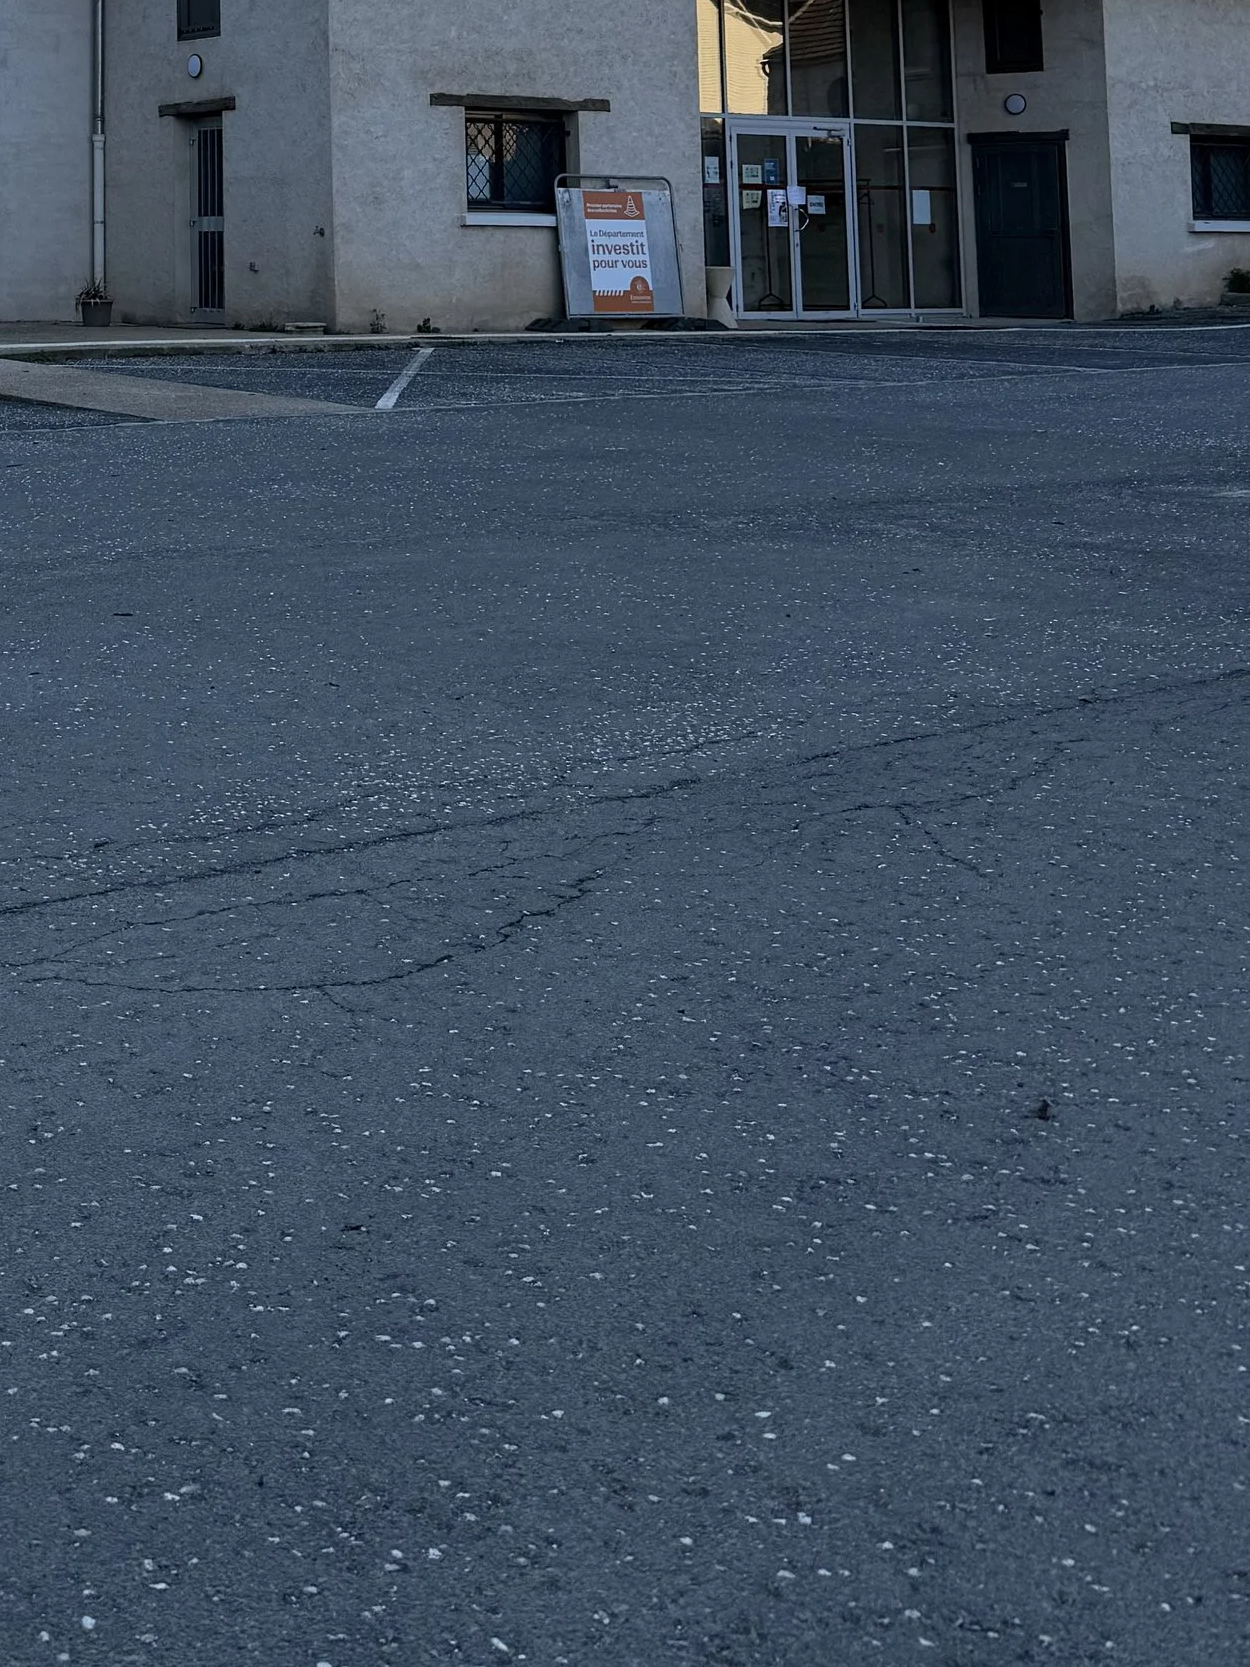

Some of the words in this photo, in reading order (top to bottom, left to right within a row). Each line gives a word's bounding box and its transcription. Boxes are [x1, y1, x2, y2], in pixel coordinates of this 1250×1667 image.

[591, 239, 646, 255] investit
[593, 259, 619, 271] pour
[621, 259, 648, 269] vous
